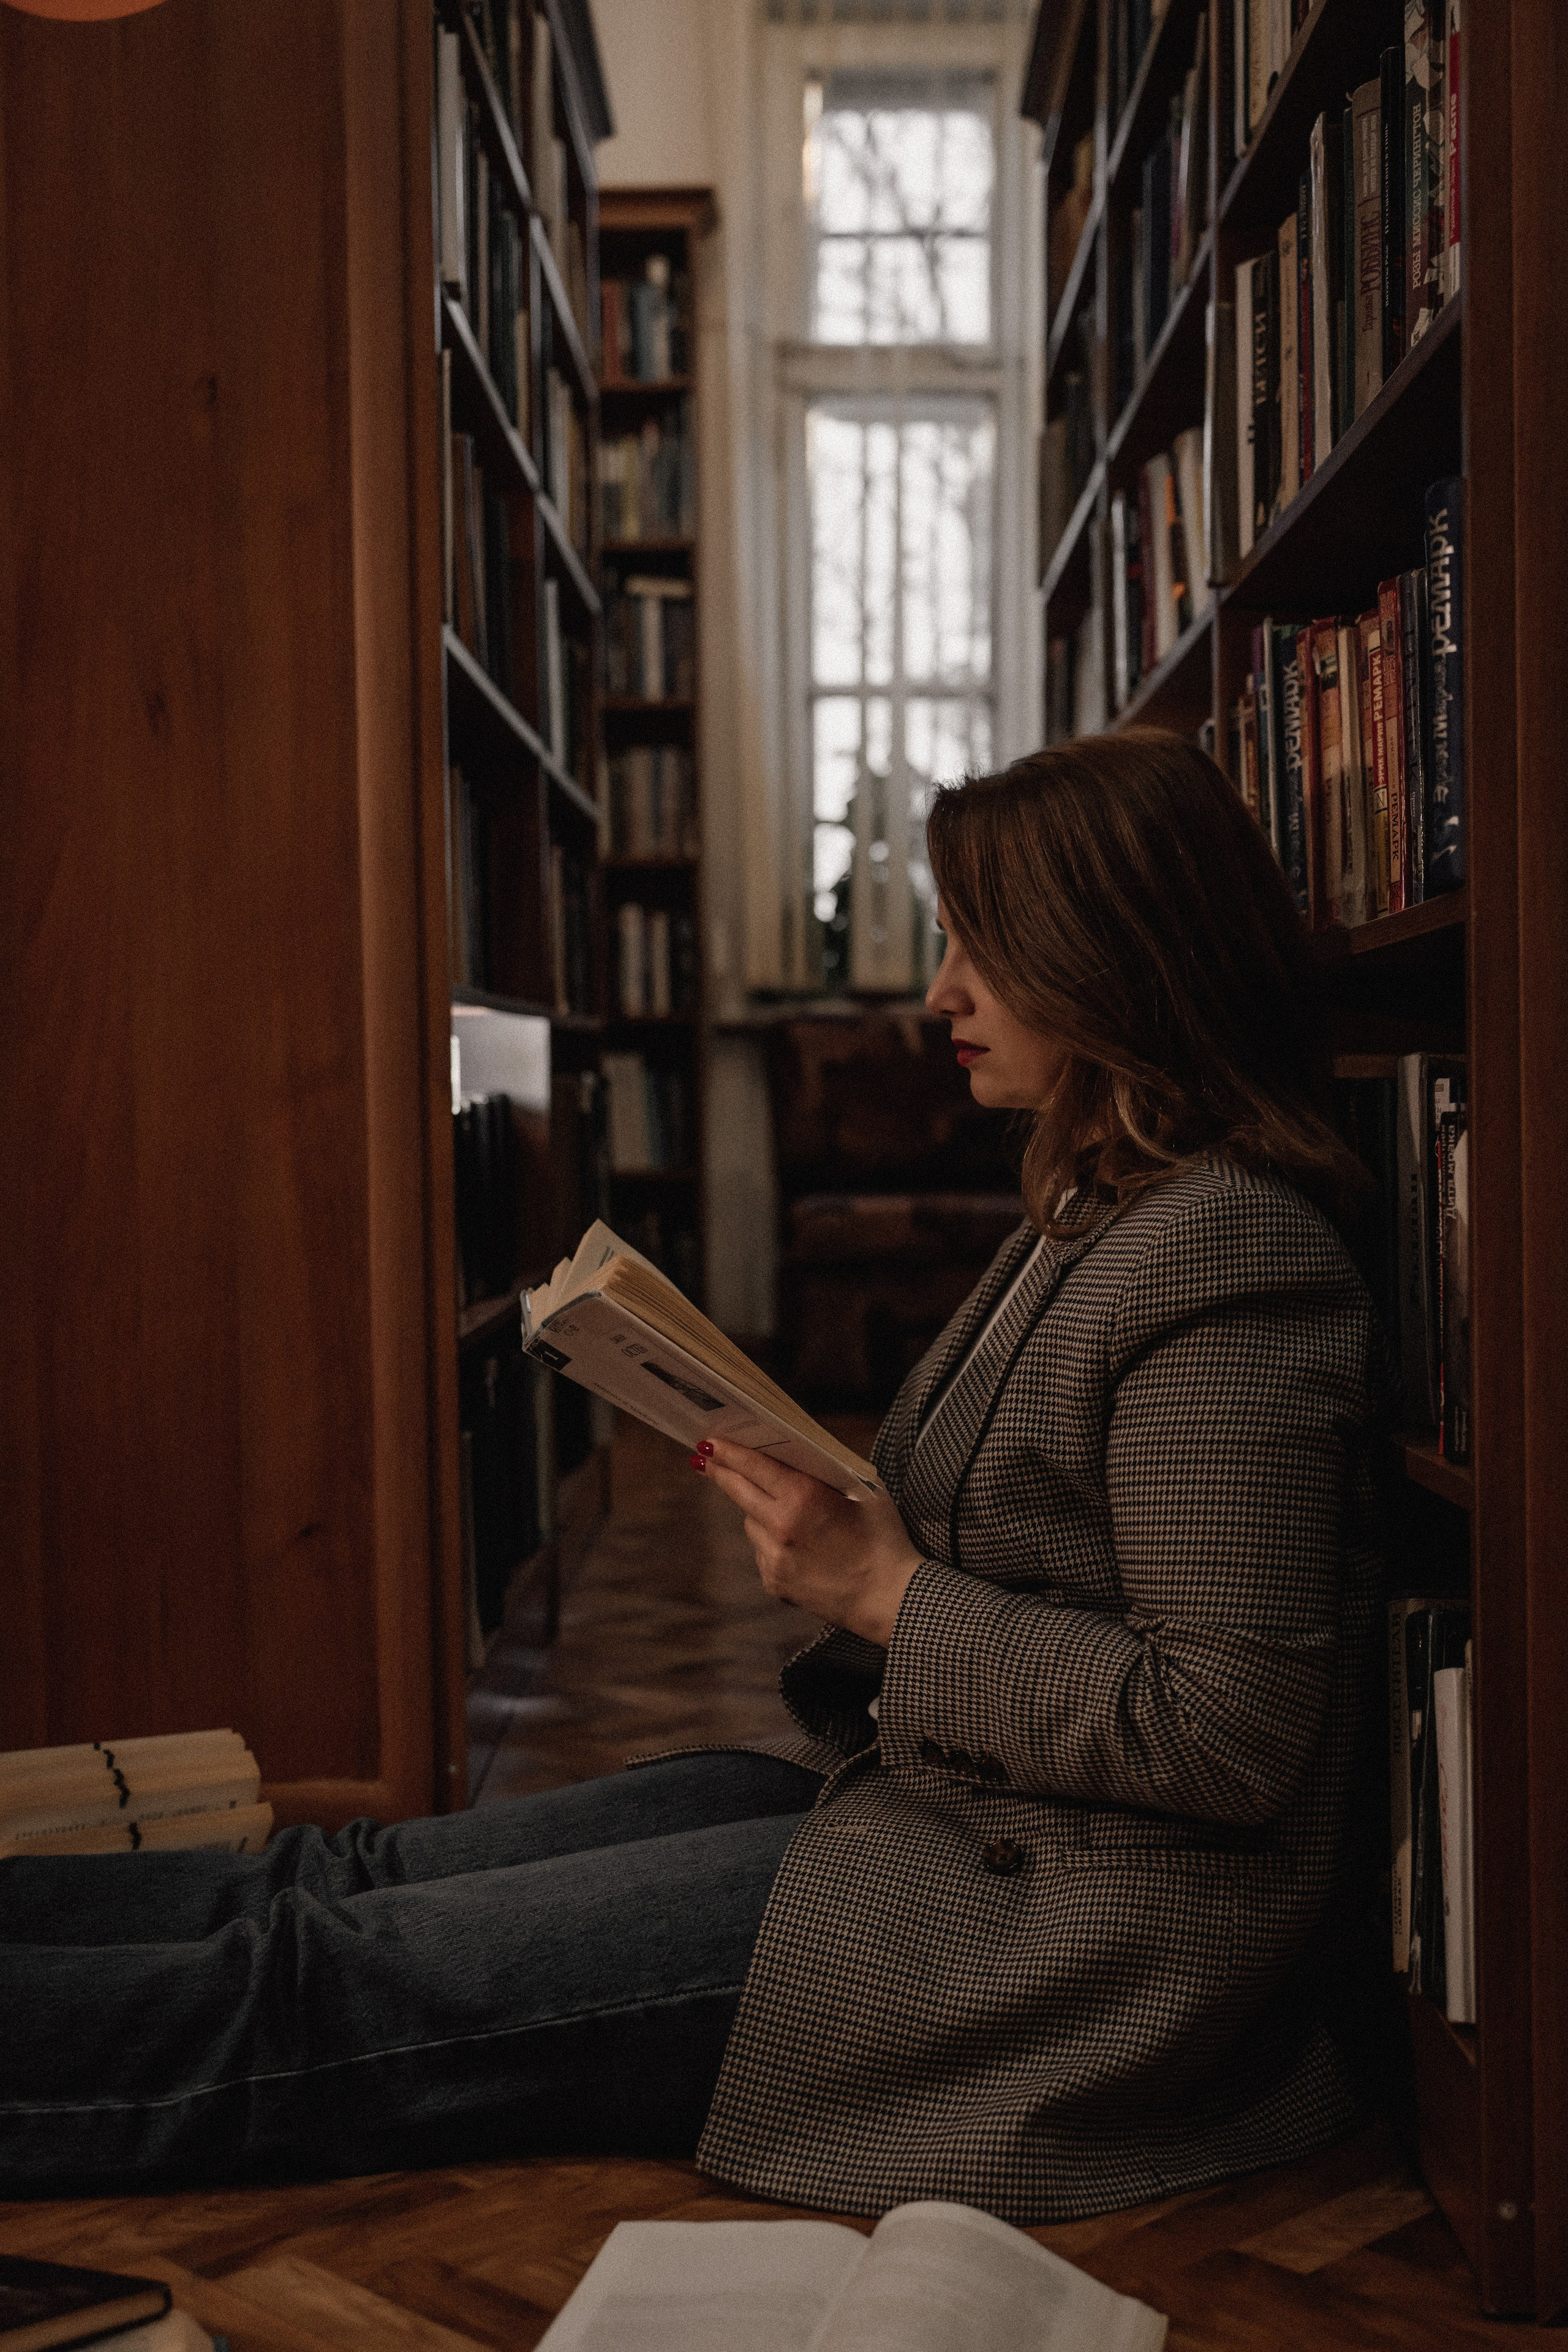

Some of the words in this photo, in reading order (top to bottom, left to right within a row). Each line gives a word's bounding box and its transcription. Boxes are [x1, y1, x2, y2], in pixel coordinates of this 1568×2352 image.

[1412, 102, 1422, 189] ЧЕРИНГТОН
[1412, 189, 1422, 247] МИССИС
[1360, 211, 1381, 295] РОББИНС
[1412, 250, 1422, 290] РОЗЫ
[1371, 655, 1384, 722] РЕМАРК
[1376, 723, 1385, 756] МАРИЯ
[1377, 757, 1385, 782] ЭРИХ
[1390, 791, 1400, 861] РЕМАРК
[1446, 1125, 1456, 1174] мрака
[1446, 1178, 1457, 1219] Дитя
[1392, 1613, 1401, 1754] ПОСЕТИТЕЛИ
